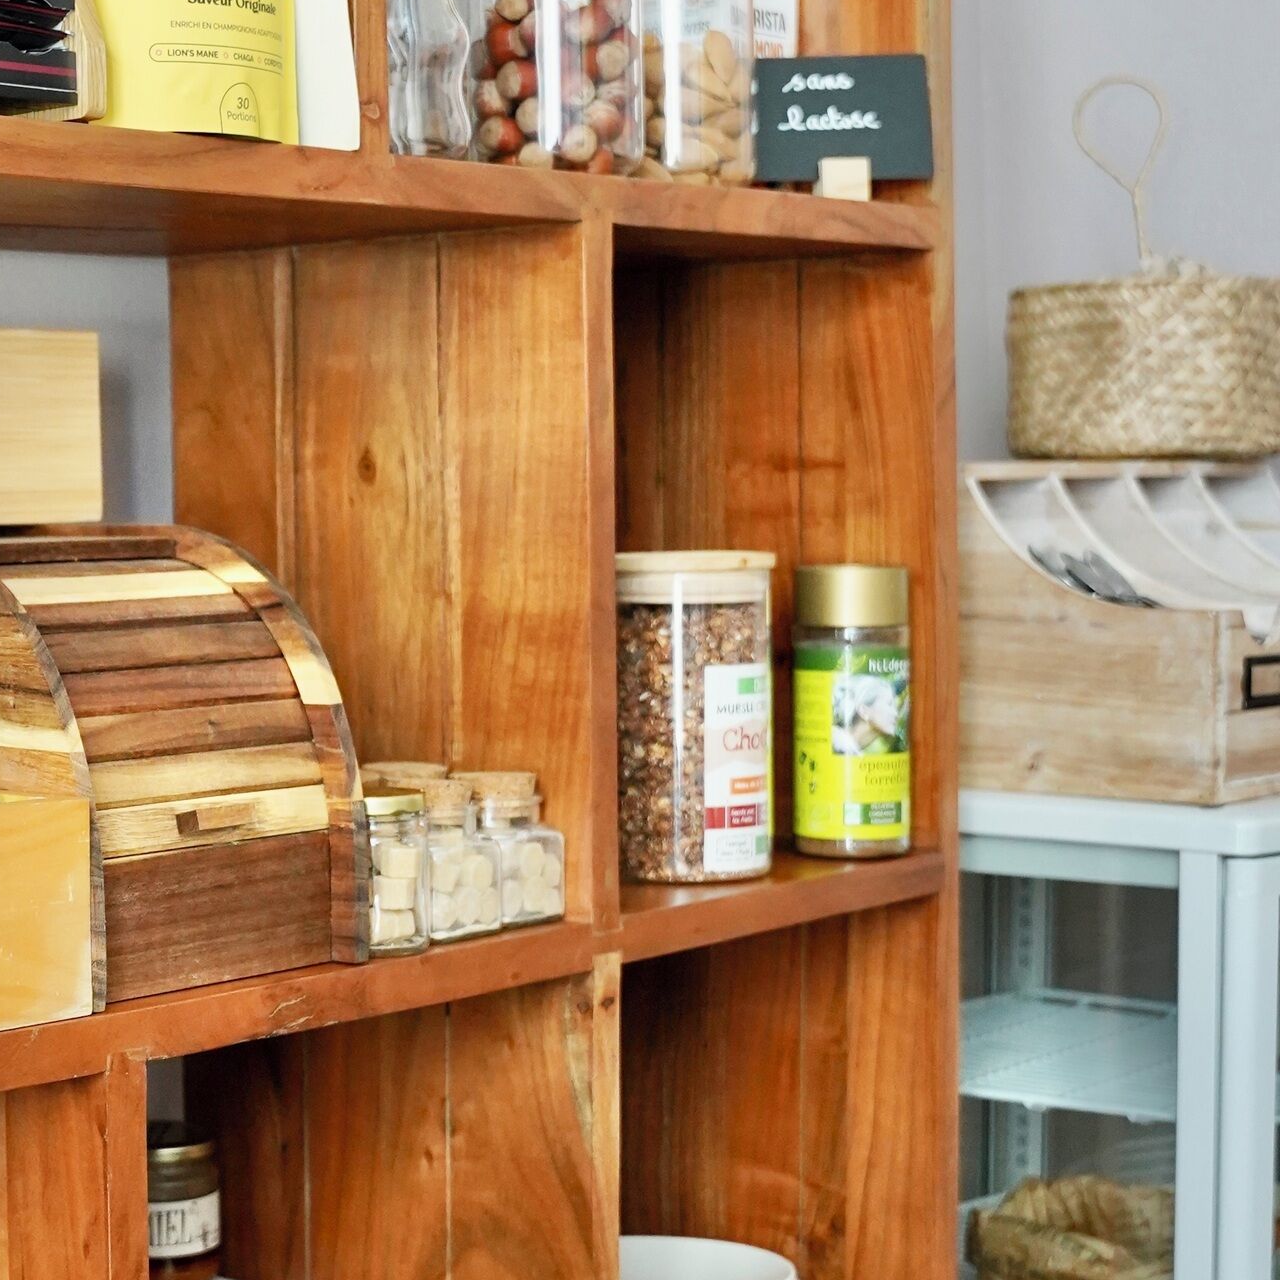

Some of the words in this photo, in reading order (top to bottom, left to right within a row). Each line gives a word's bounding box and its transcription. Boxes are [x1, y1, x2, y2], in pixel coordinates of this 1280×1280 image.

[170, 20, 201, 29] ENRICHI
[202, 21, 212, 30] EN
[167, 48, 195, 58] LION'S
[196, 49, 219, 59] MANE
[781, 72, 855, 93] sans
[236, 97, 250, 110] 30
[226, 110, 257, 123] Portions
[777, 104, 882, 131] lactose
